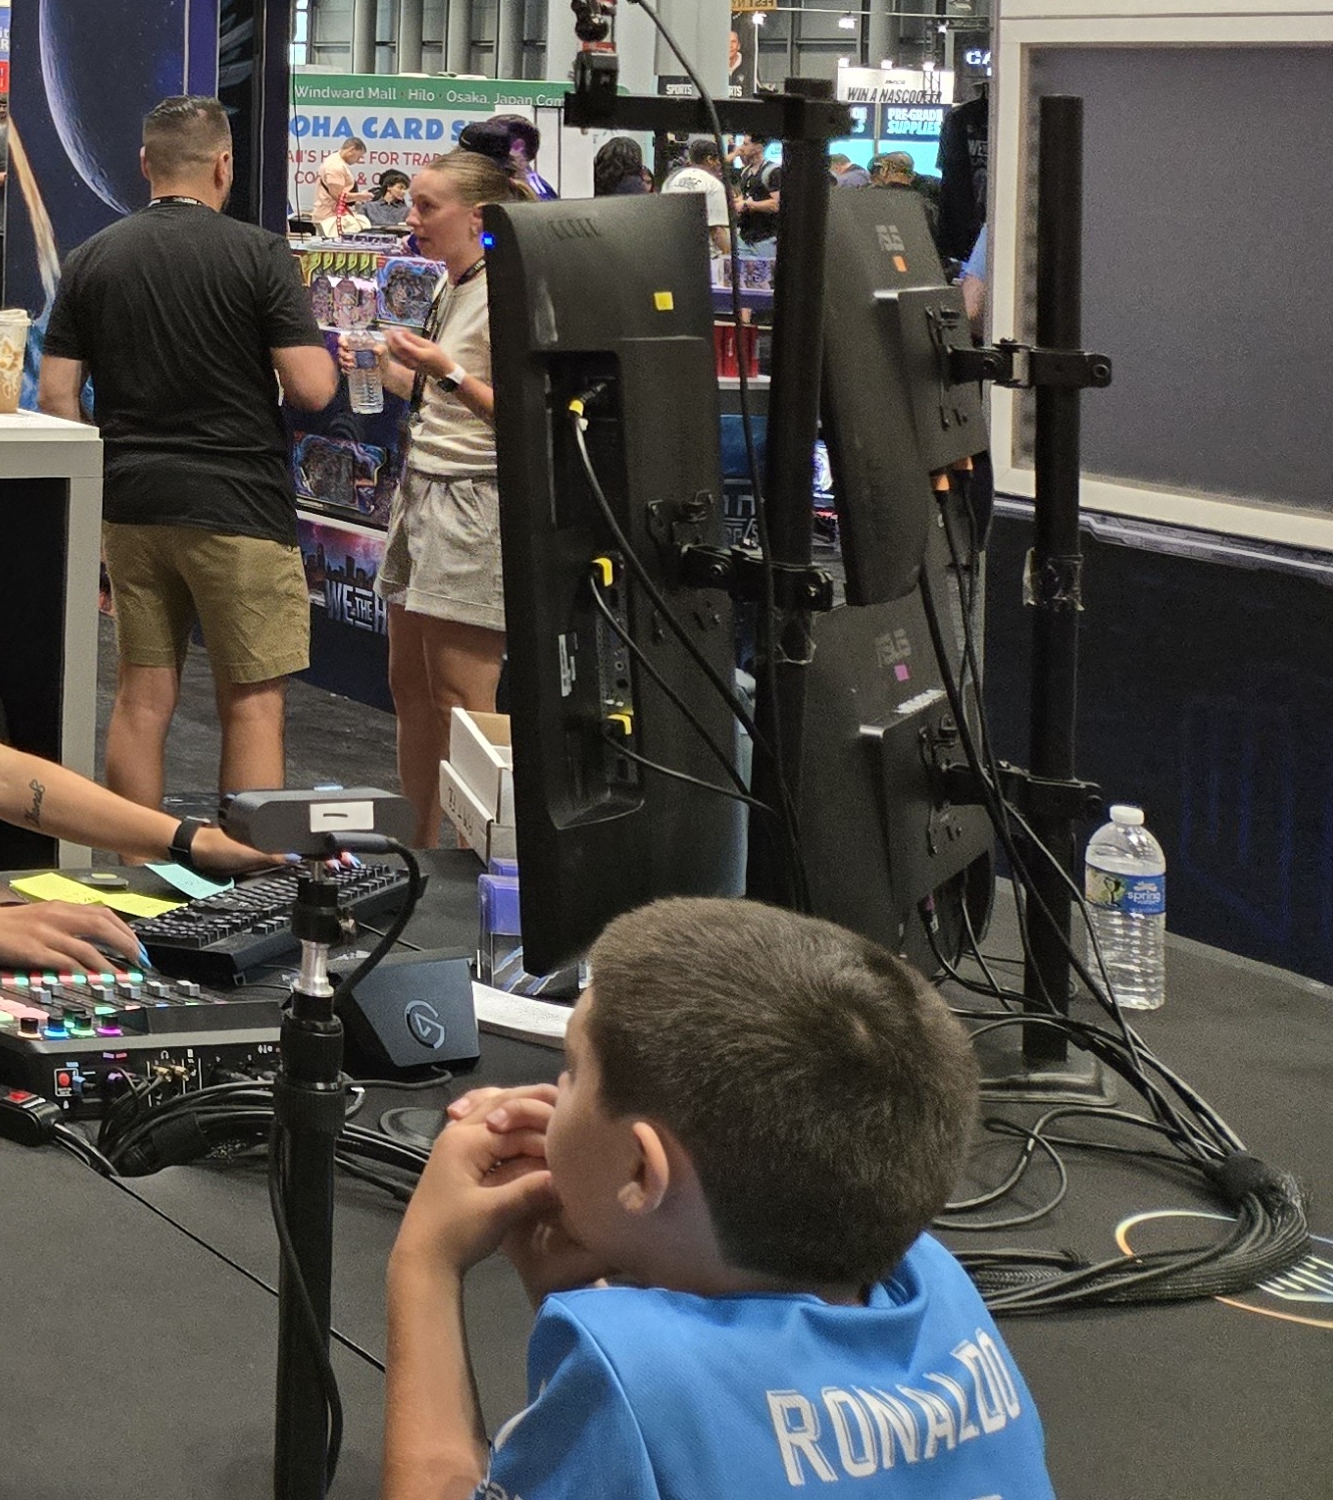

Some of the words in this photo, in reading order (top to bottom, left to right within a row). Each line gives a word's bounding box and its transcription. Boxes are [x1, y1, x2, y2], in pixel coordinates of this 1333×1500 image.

[295, 85, 365, 100] Windward
[368, 86, 398, 101] Mall
[407, 88, 435, 102] Hilo
[494, 93, 533, 106] Japan
[665, 83, 693, 96] SPORTS
[289, 114, 357, 140] OHA
[368, 116, 445, 142] CARD
[886, 120, 942, 136] SUPPLIES
[369, 150, 399, 166] FOR
[352, 596, 374, 623] THE
[1127, 889, 1162, 903] spring
[765, 1327, 1021, 1487] RONALDO
